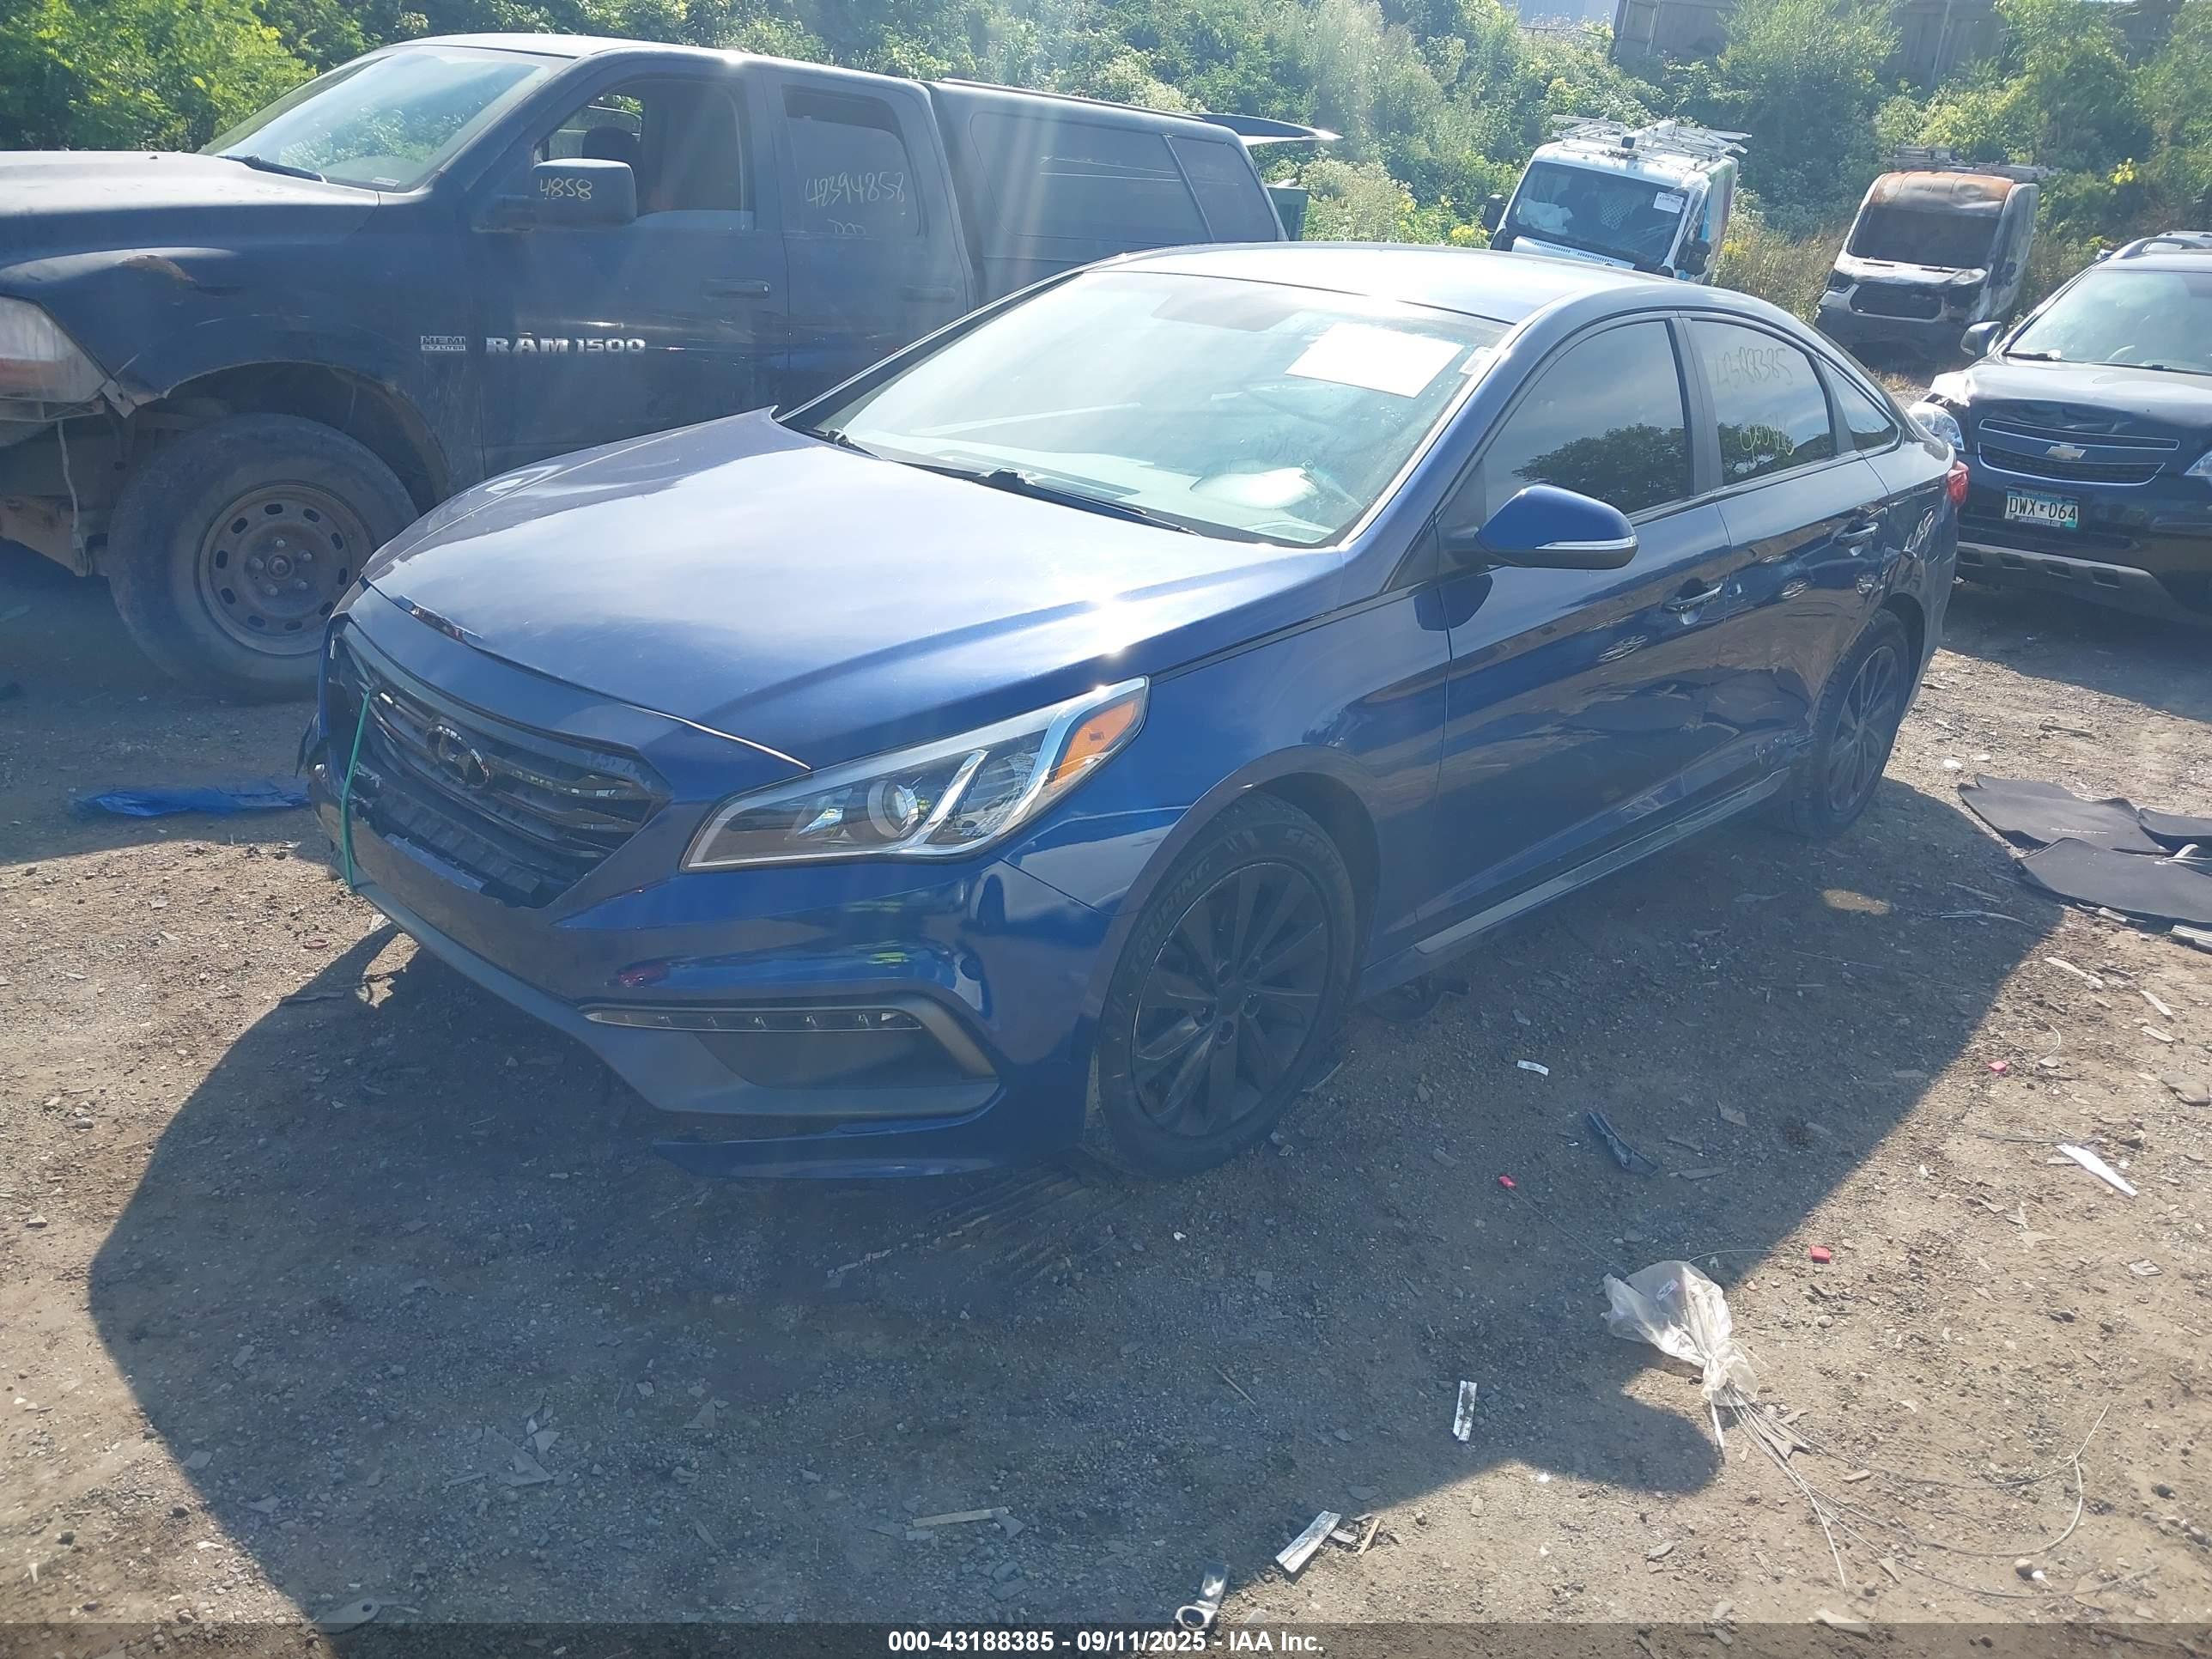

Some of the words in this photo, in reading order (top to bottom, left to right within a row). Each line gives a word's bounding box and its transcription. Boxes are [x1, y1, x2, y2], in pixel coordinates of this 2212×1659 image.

[539, 177, 593, 200] 4858
[422, 336, 465, 344] HEMI
[485, 337, 569, 353] RAM
[576, 337, 646, 354] 1500
[2008, 497, 2037, 516] DWX
[2048, 502, 2076, 520] 064
